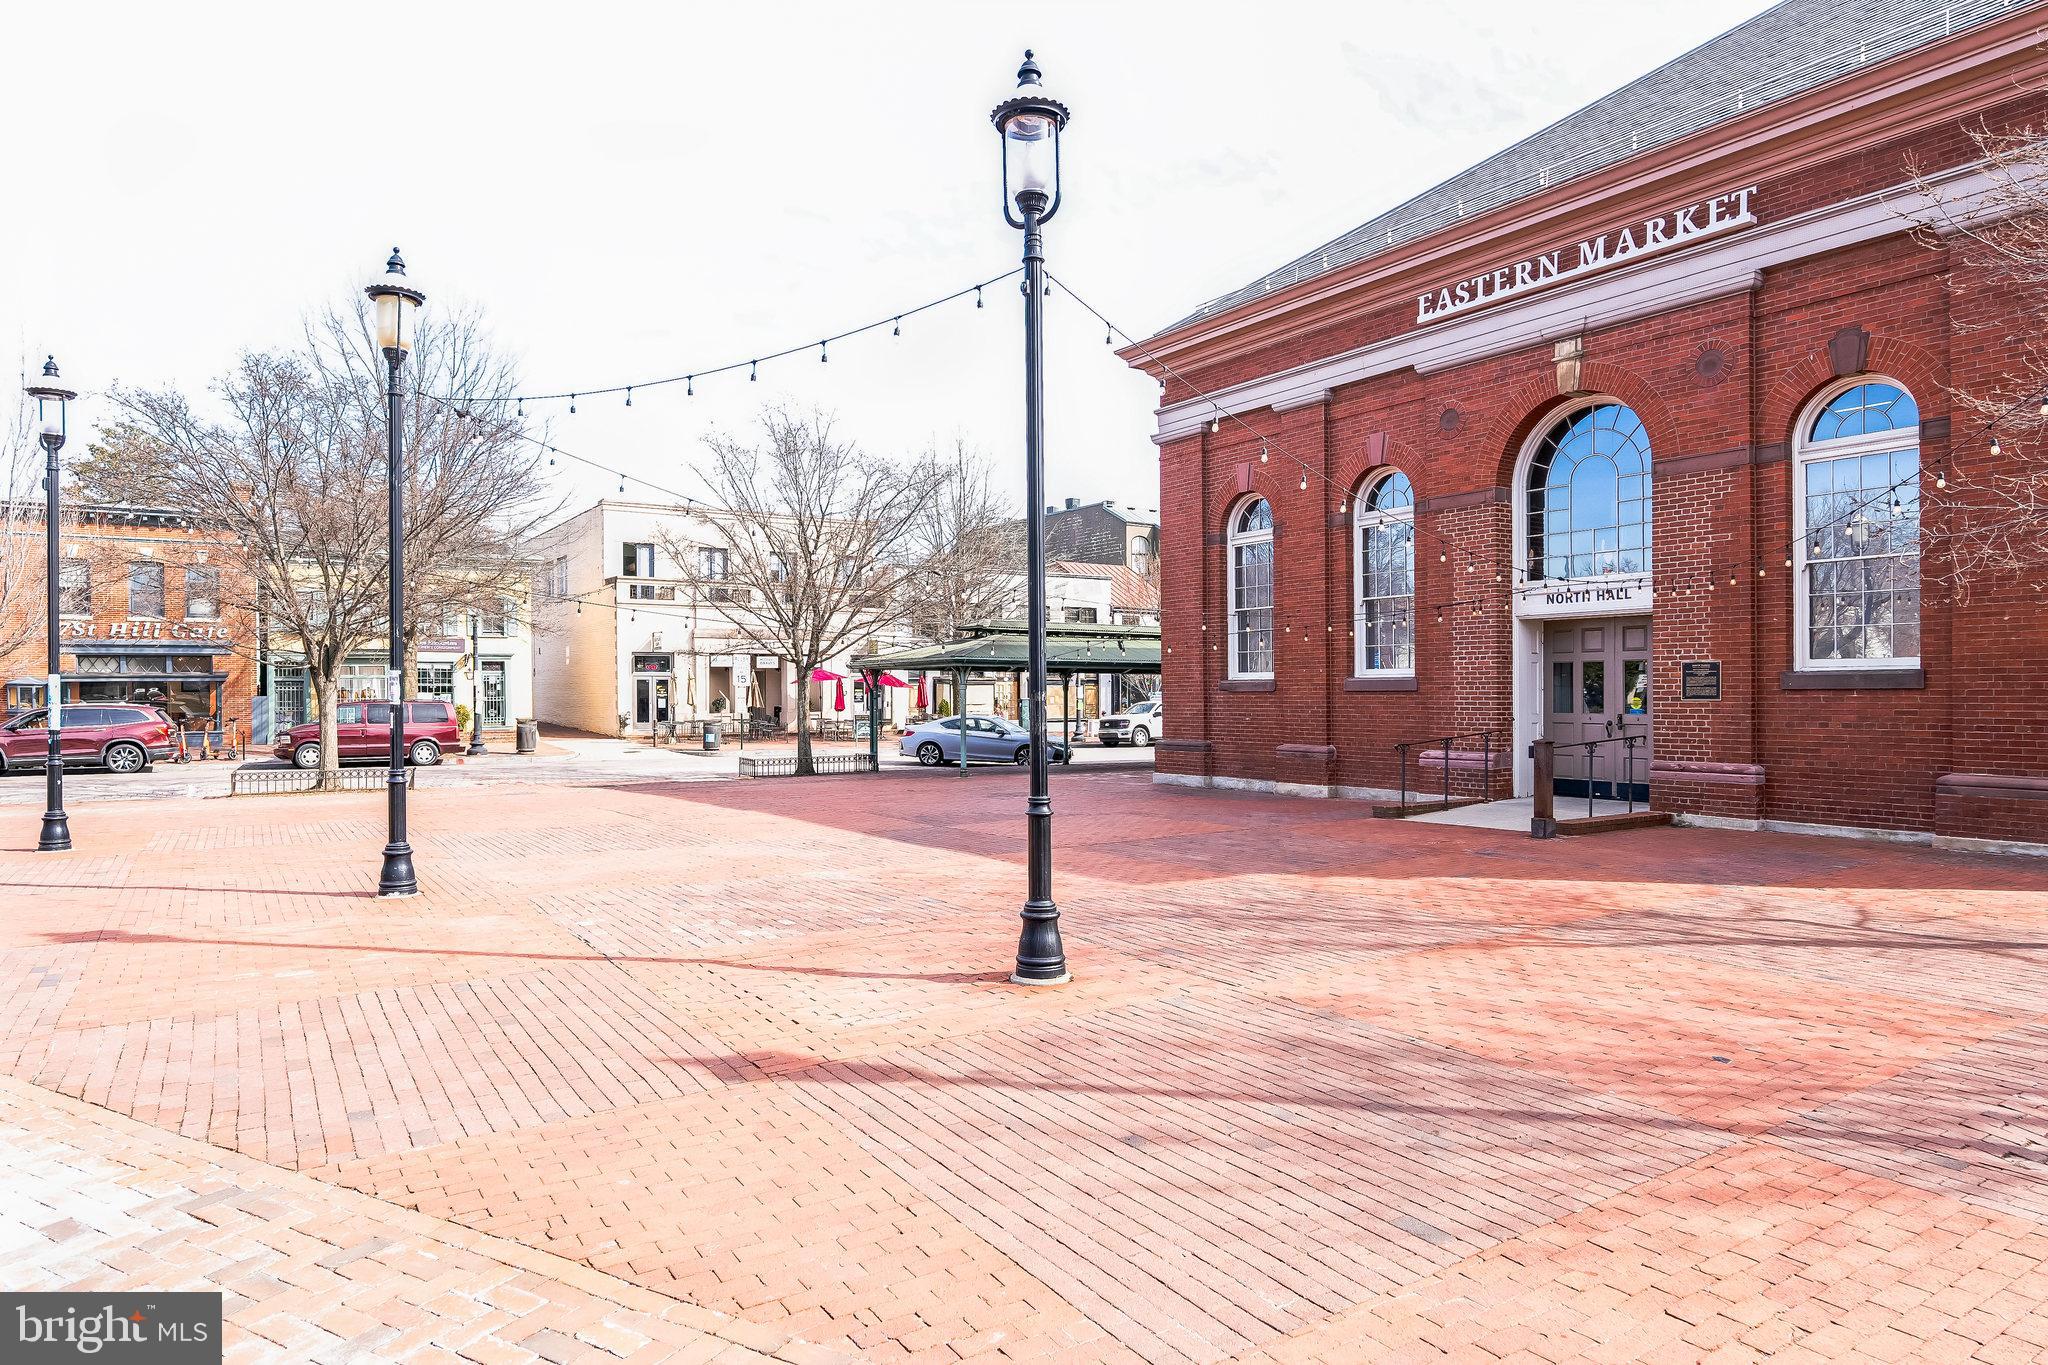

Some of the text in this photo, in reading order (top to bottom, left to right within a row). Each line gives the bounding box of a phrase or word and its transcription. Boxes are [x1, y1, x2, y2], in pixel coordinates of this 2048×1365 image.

[1416, 185, 1757, 319] EASTERN MARKET
[1546, 588, 1632, 604] NORTH HALL
[110, 622, 162, 638] Hill
[737, 675, 746, 683] 15
